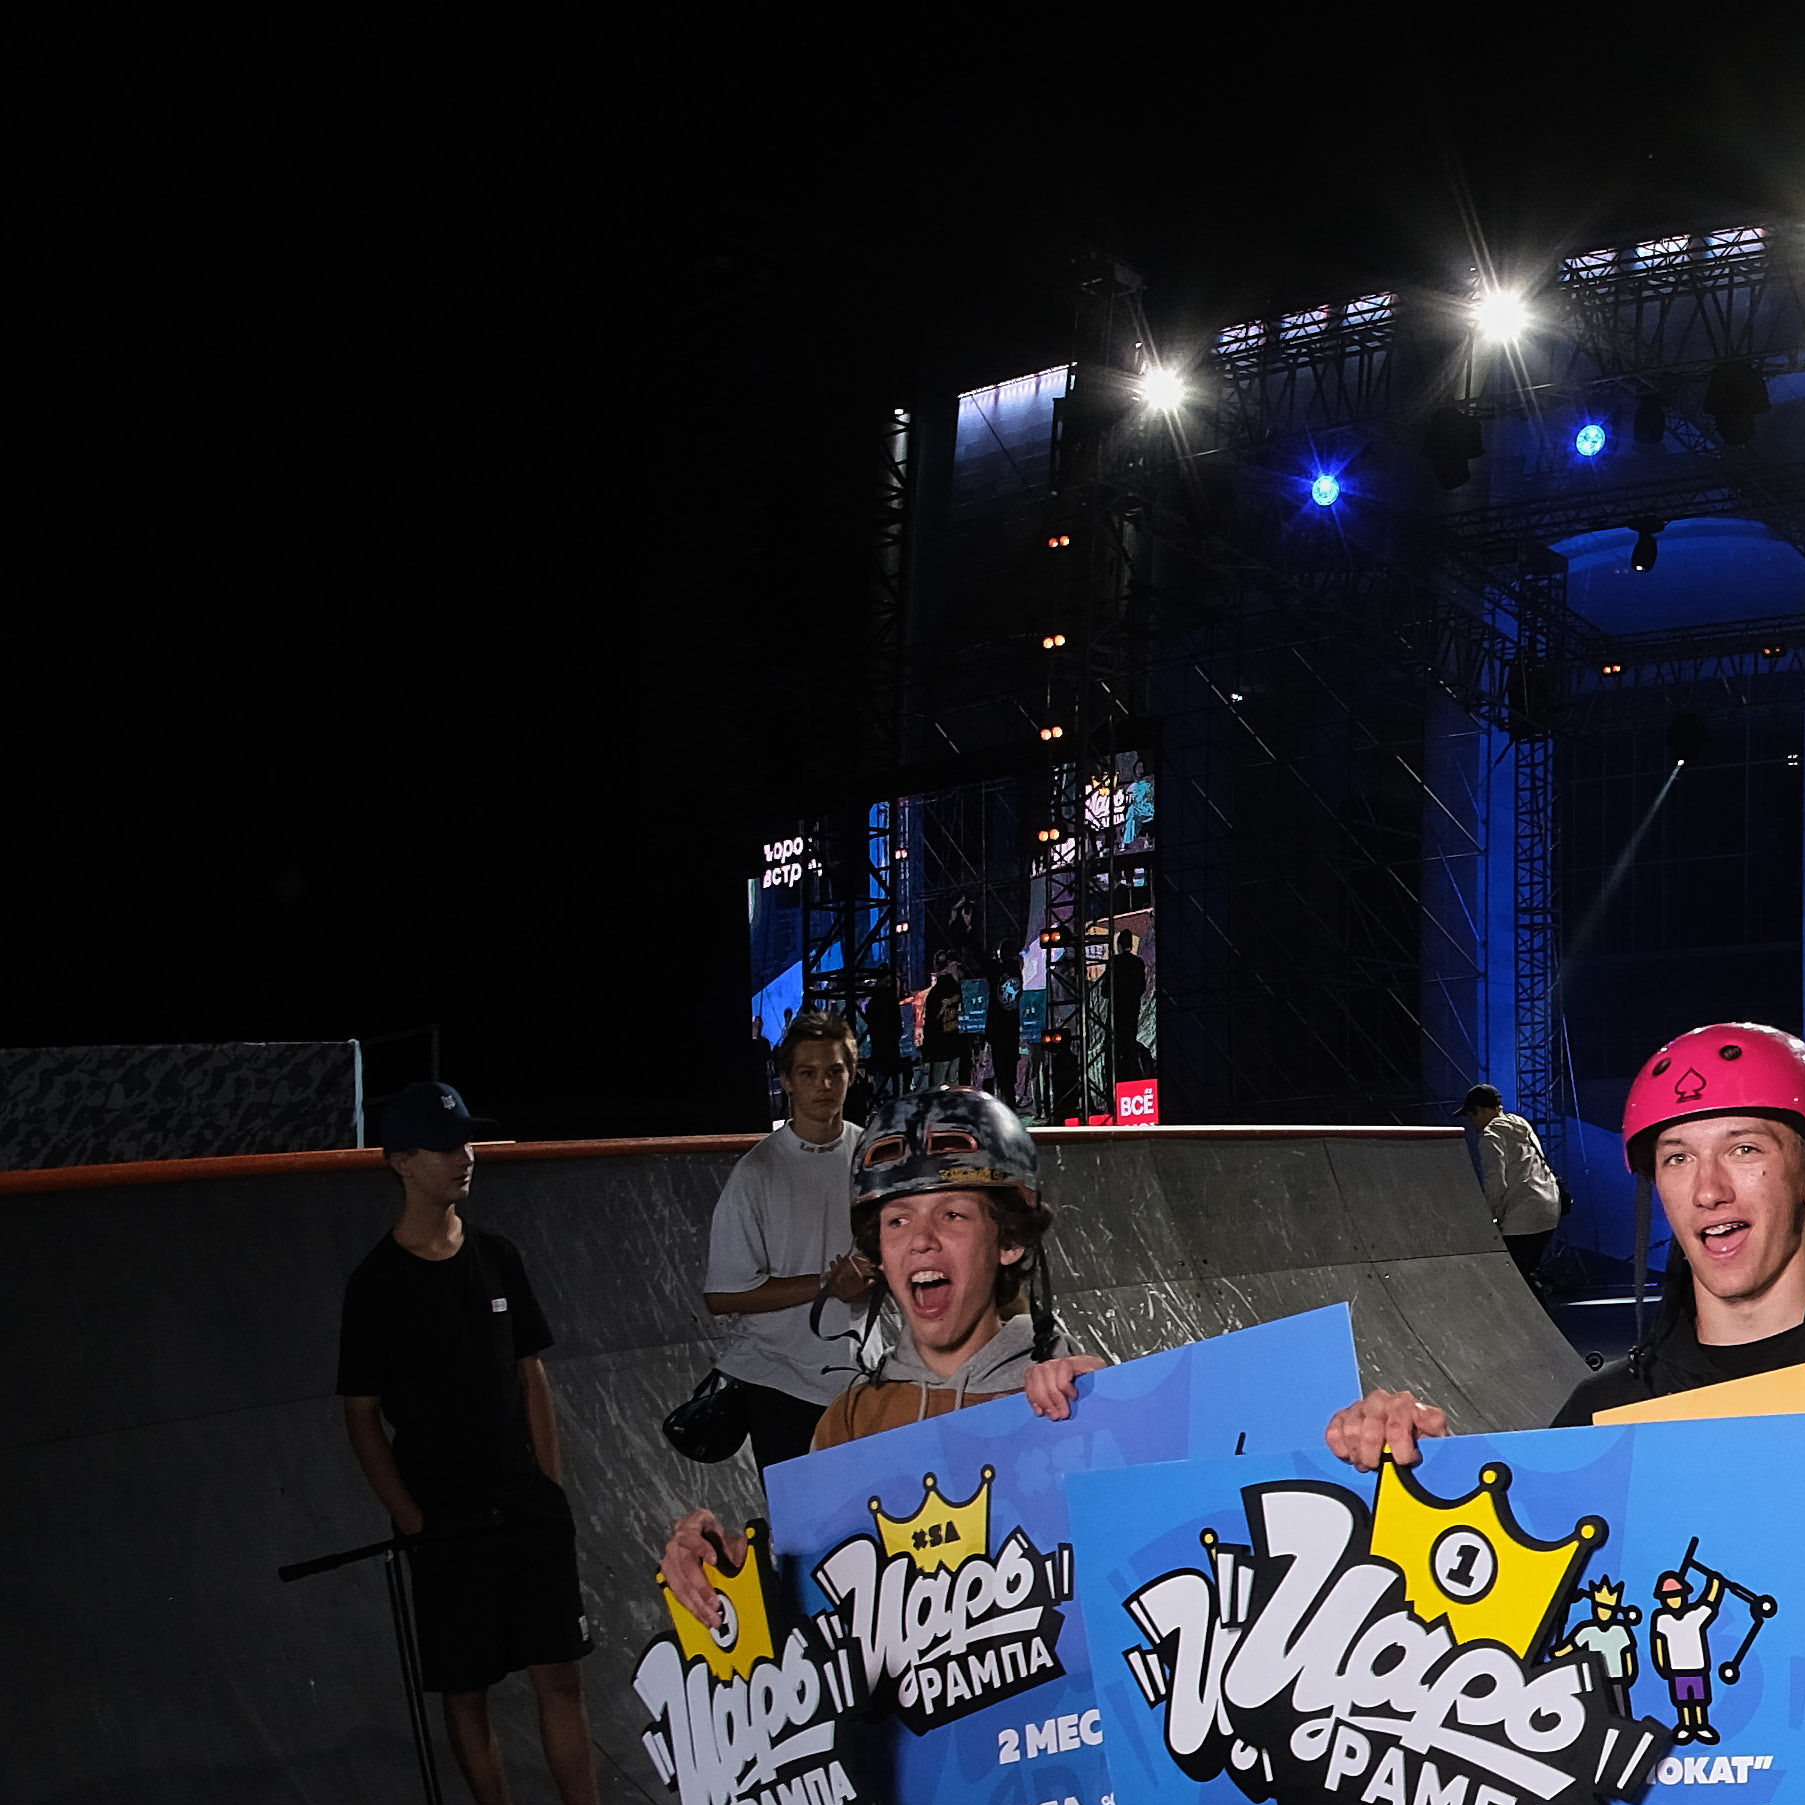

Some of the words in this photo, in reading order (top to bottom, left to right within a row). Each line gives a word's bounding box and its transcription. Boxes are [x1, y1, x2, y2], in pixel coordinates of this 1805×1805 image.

[1450, 1543, 1478, 1587] 1
[918, 1634, 1054, 1716] РАМПА
[998, 1729, 1021, 1764] 2
[1026, 1709, 1103, 1759] МЕС
[1647, 1756, 1775, 1785] ОКАТ"
